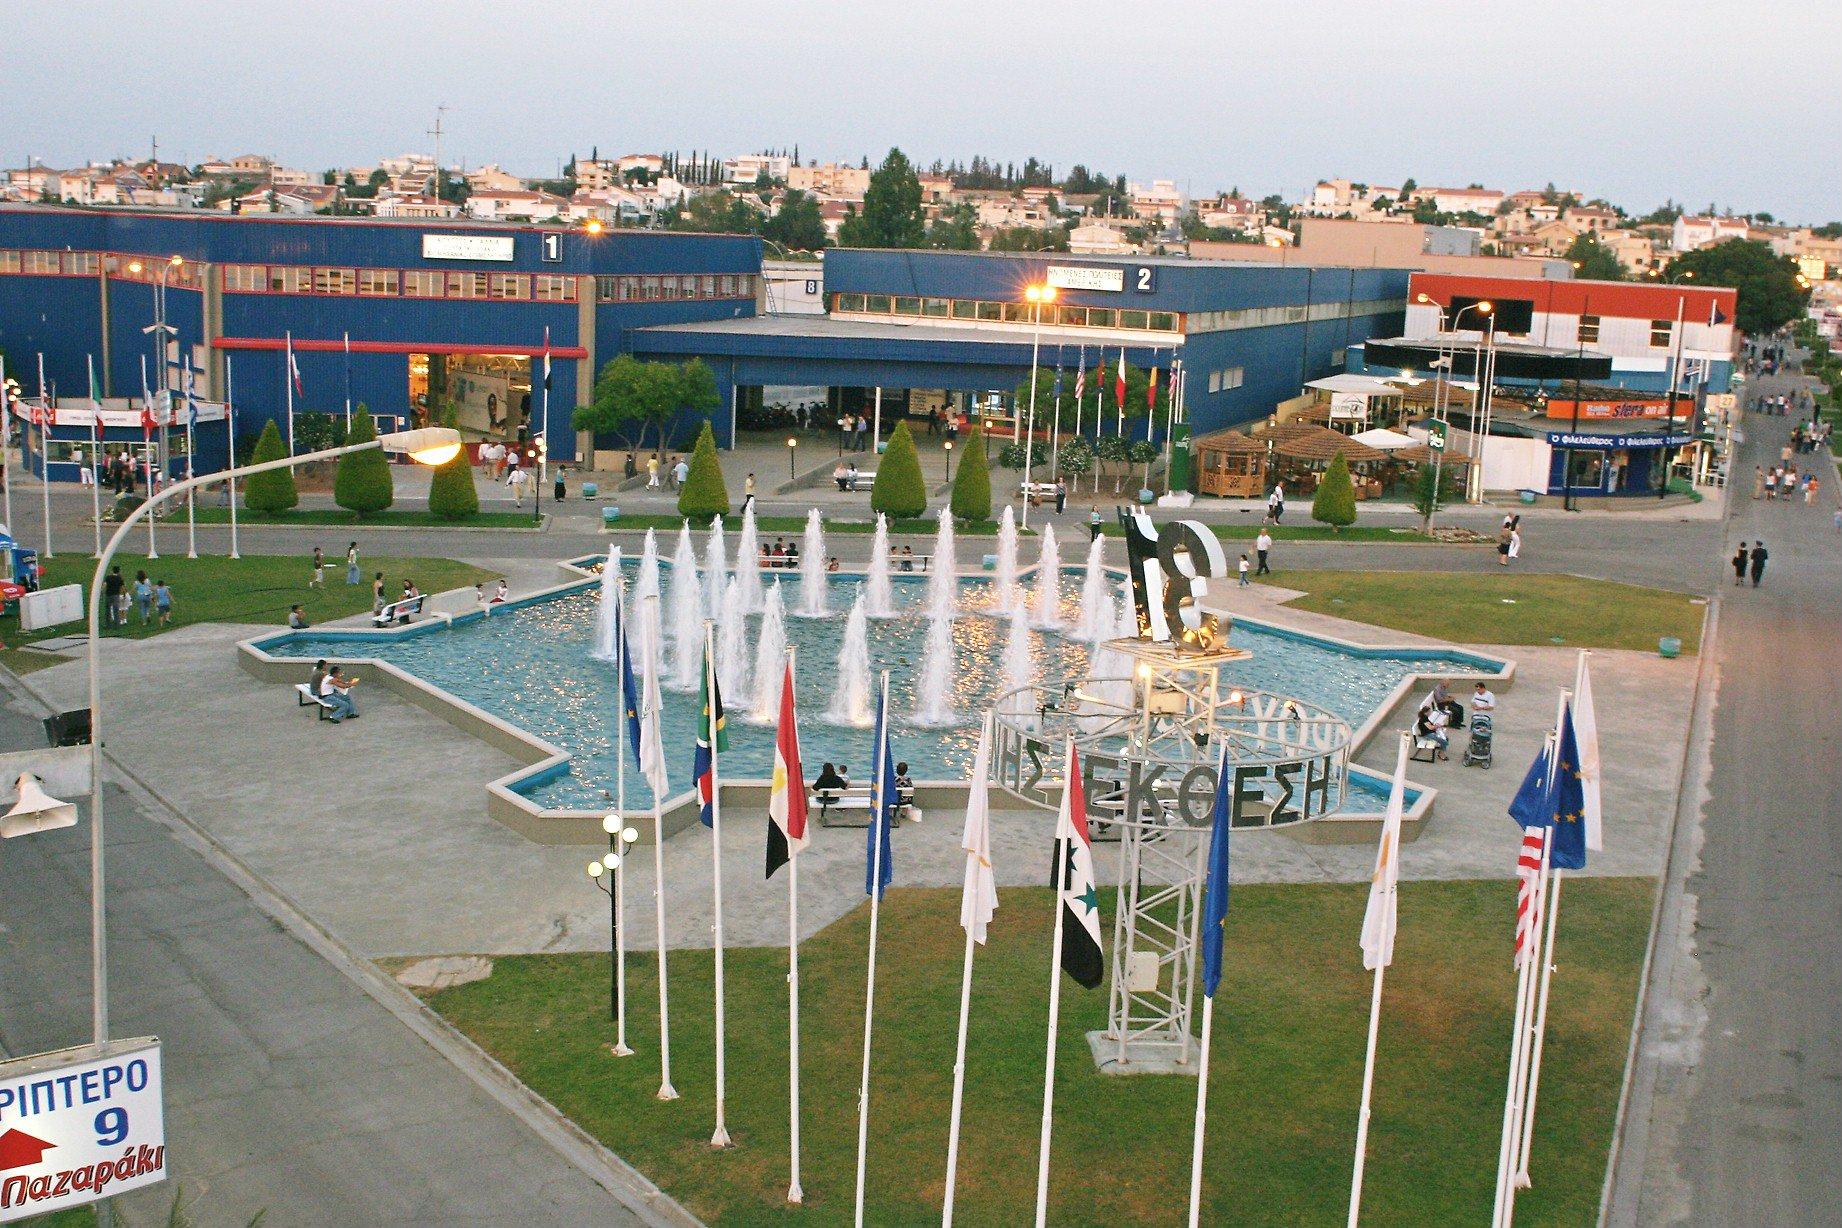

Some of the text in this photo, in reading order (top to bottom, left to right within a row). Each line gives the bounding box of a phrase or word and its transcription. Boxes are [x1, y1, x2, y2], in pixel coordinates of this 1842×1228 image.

[546, 235, 557, 259] 1
[807, 280, 816, 294] 8
[1137, 268, 1151, 290] 2
[1083, 754, 1331, 828] ΕΚΘΕΣΗ
[93, 1106, 130, 1147] 9
